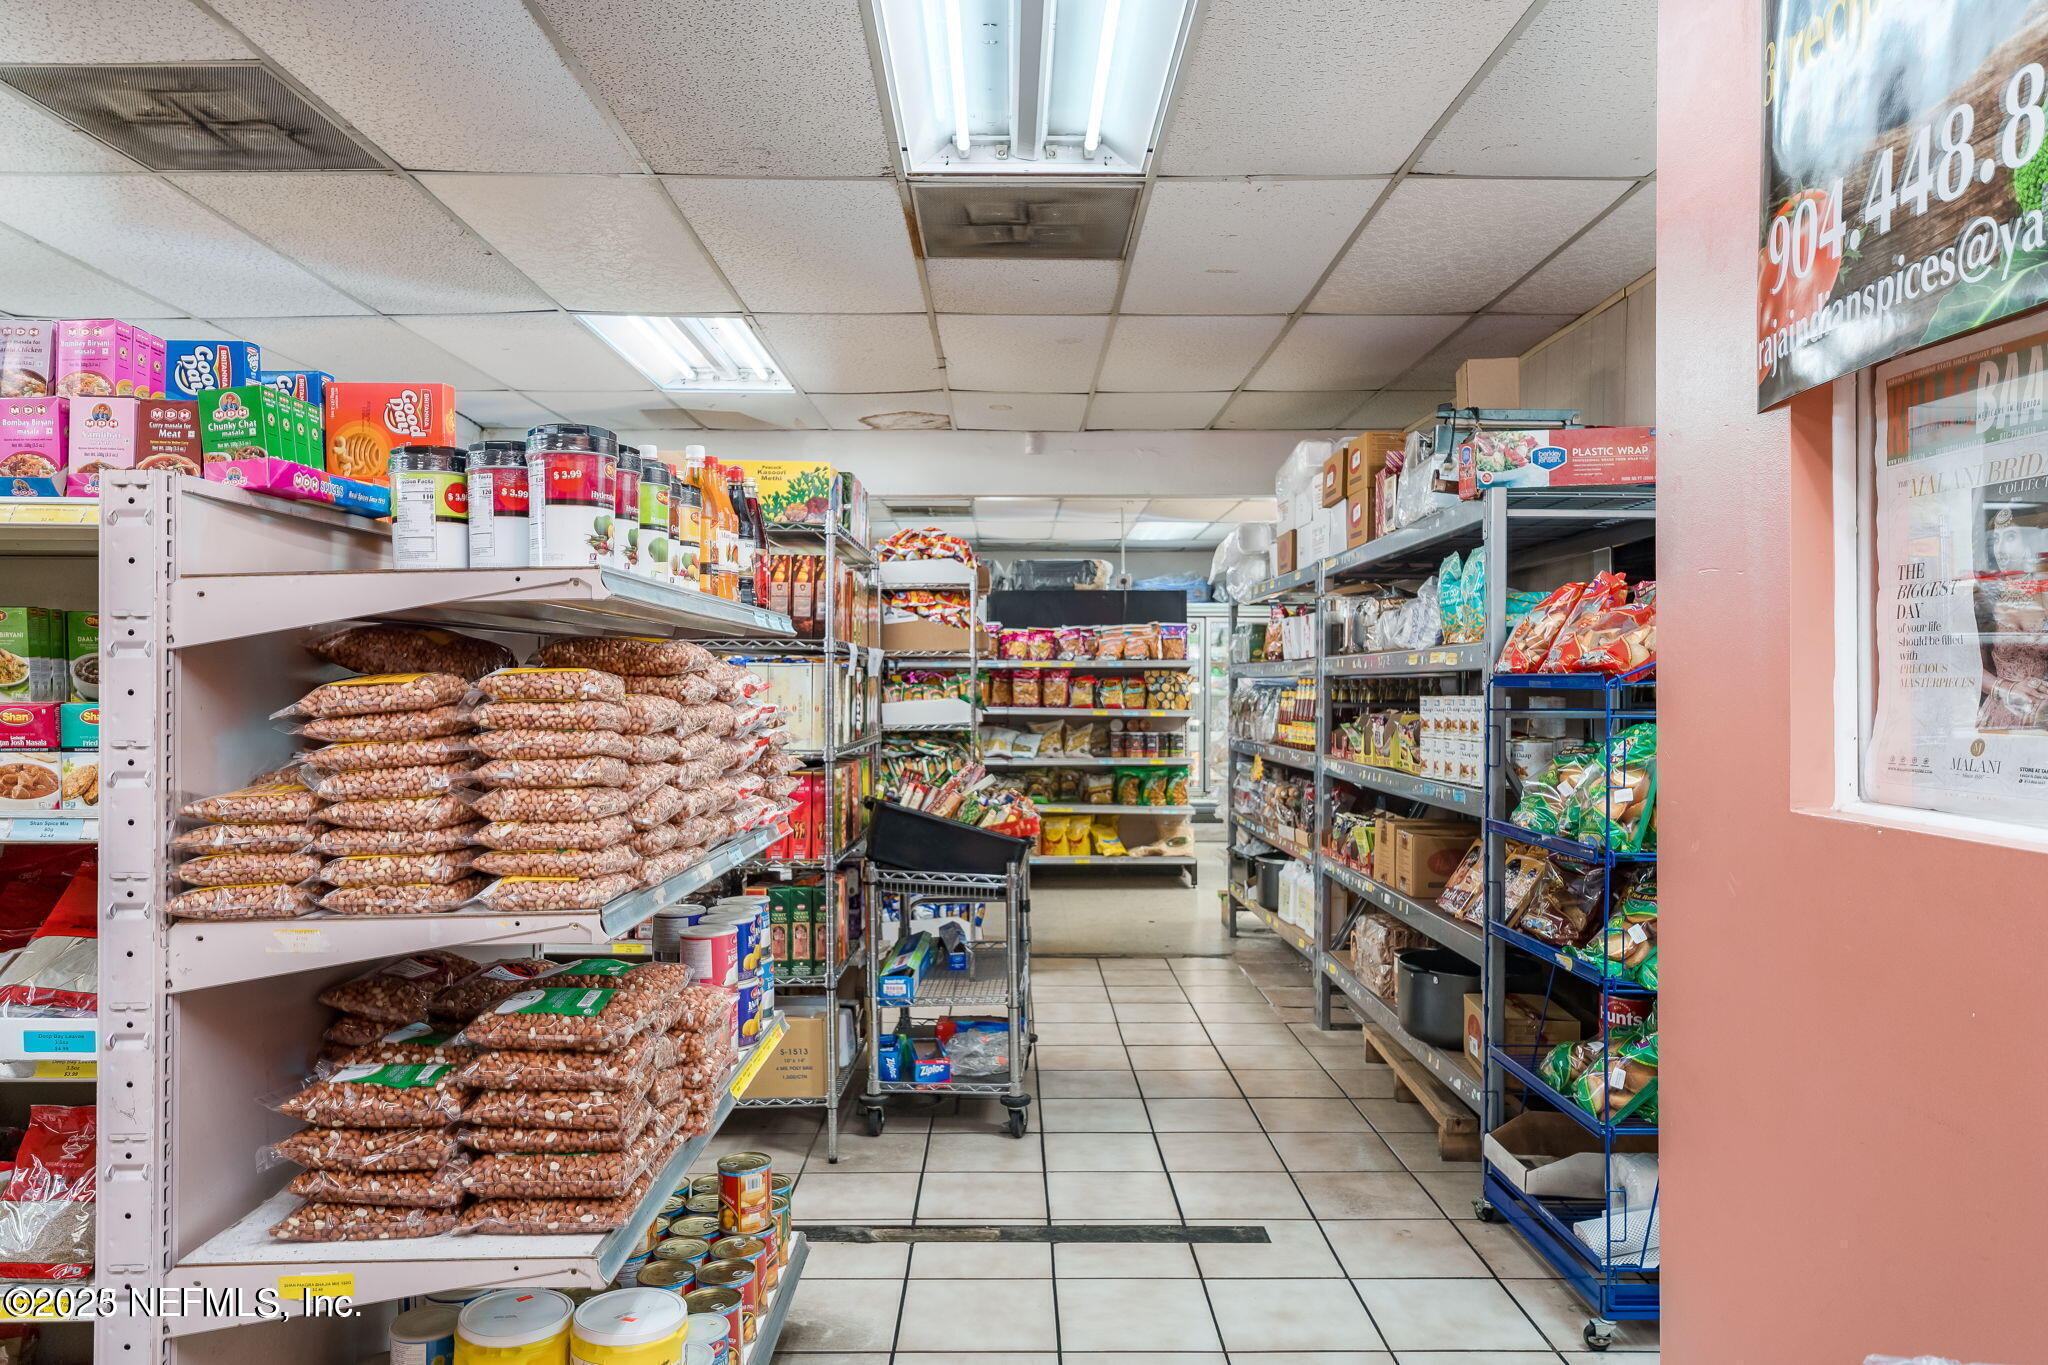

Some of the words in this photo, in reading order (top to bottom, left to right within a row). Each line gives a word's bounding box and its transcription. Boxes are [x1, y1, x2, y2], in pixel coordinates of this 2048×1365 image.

[2, 328, 39, 336] MDH
[67, 327, 104, 336] MDH
[218, 348, 228, 389] BRITANNIA
[10, 404, 48, 416] MDH
[150, 408, 192, 422] MDH
[213, 408, 250, 422] MDH
[400, 389, 428, 438] Good
[423, 392, 431, 428] BRITANNIA
[2, 418, 29, 427] Bombay
[31, 418, 54, 426] Biryani
[84, 419, 120, 429] MDH
[207, 420, 237, 432] Chunky
[238, 418, 257, 429] Chat
[158, 429, 181, 439] Meat
[1538, 450, 1562, 458] berkley
[1572, 447, 1614, 456] PLASTIC
[1617, 446, 1649, 455] WRAP
[1986, 450, 2048, 486] BRID
[553, 471, 559, 480] $
[562, 469, 582, 480] 3.99
[293, 471, 320, 493] MDH
[320, 480, 345, 498] SPICES
[447, 492, 454, 501] $
[501, 487, 508, 496] $
[509, 489, 529, 498] 3.99
[1897, 562, 1925, 580] THE
[1896, 580, 1957, 600] BIGGEST
[1896, 602, 1924, 619] DAY
[1190, 623, 1198, 633] 9
[1897, 623, 1906, 633] of
[1907, 623, 1927, 636] your
[1928, 620, 1942, 632] life
[1898, 635, 1927, 647] should
[1929, 635, 1940, 646] be
[1941, 634, 1964, 645] filled
[1899, 650, 1918, 661] with
[1900, 663, 1949, 674] PRECIOUS
[1901, 677, 1976, 689] MASTERPIECES
[2, 712, 31, 722] Shan
[83, 711, 98, 722] Sha
[11, 739, 25, 747] Josh
[26, 739, 47, 747] Masala
[83, 740, 98, 748] Fried
[1950, 757, 2002, 775] MALANI
[780, 1048, 809, 1056] S-1513
[885, 1057, 897, 1079] Ziploc
[920, 1064, 945, 1077] Ziploc
